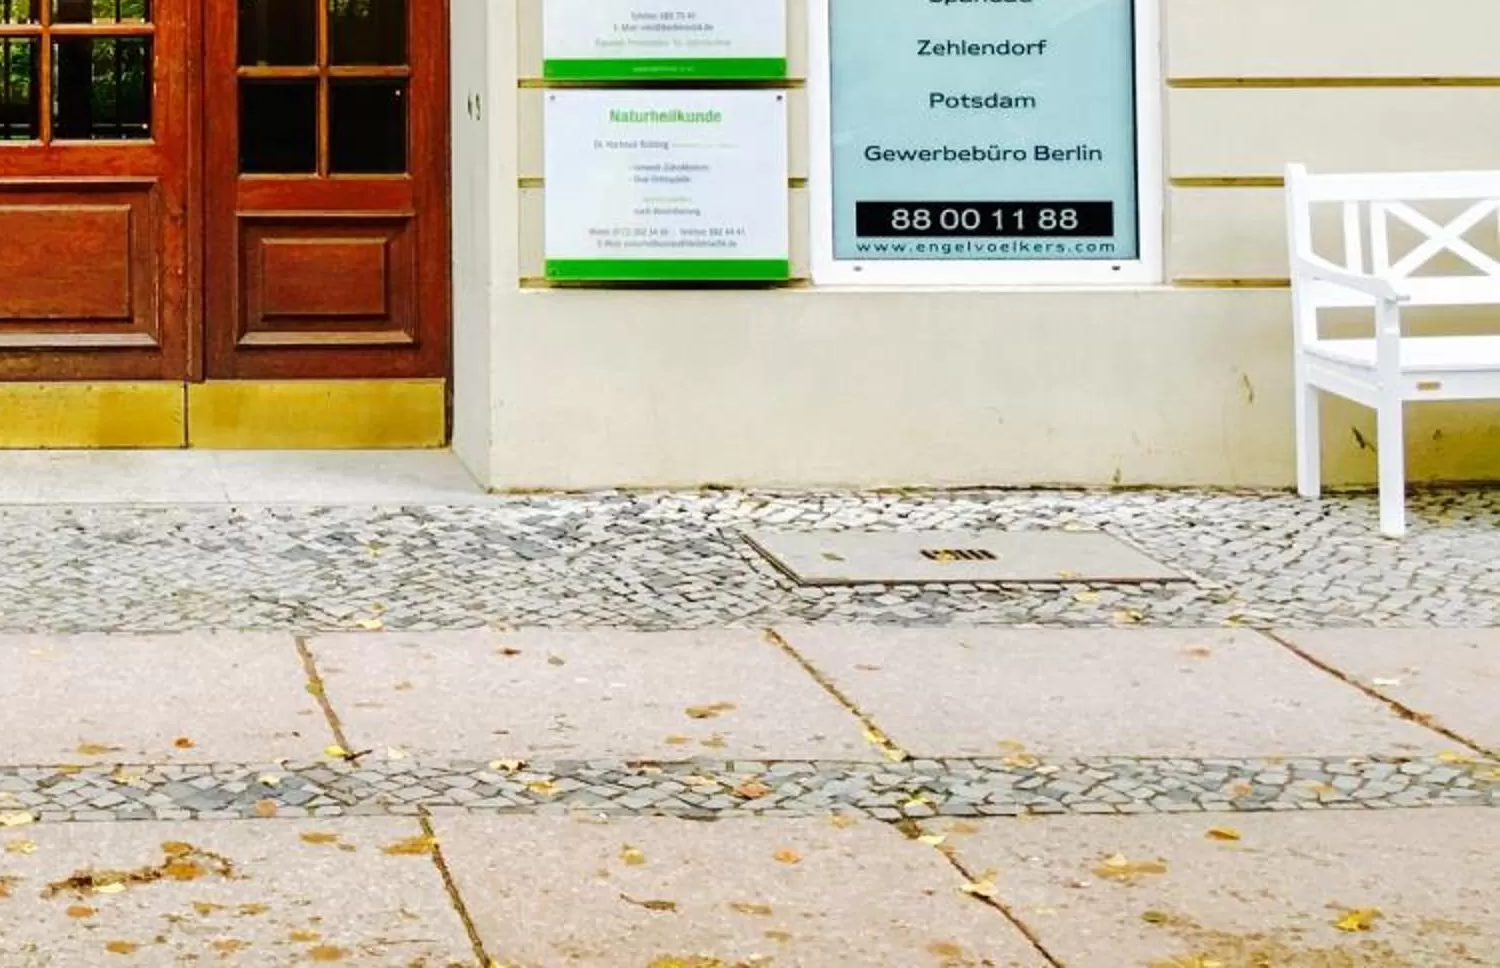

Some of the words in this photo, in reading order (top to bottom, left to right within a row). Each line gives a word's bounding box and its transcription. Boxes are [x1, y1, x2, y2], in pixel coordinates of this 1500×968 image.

[916, 39, 1048, 57] Zehlendorf
[929, 92, 1037, 109] Potsdam
[609, 108, 722, 125] Naturheilkunde
[863, 144, 1027, 163] Gewerbebüro
[1033, 144, 1103, 162] Berlin
[891, 208, 932, 231] 88
[939, 208, 981, 231] 00
[991, 208, 1025, 231] 11
[1037, 208, 1079, 231] 88
[856, 238, 1115, 255] www.engelvoelkers.com
